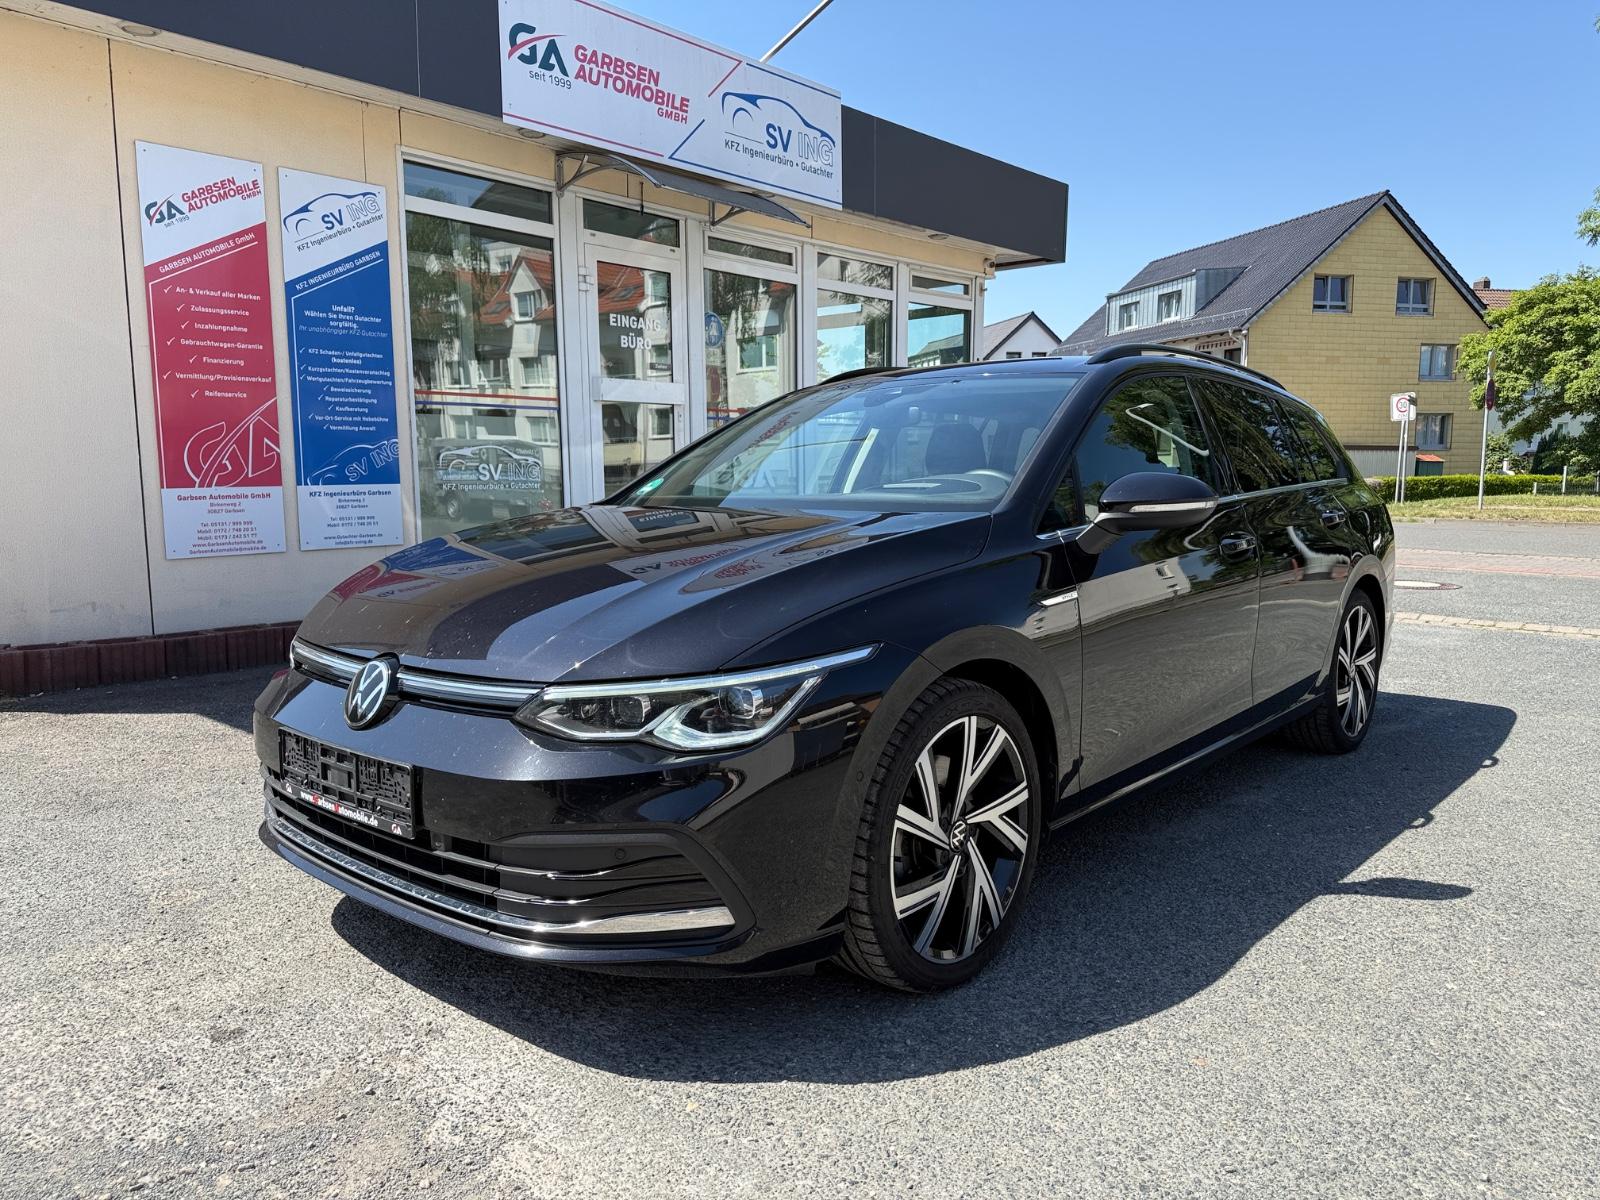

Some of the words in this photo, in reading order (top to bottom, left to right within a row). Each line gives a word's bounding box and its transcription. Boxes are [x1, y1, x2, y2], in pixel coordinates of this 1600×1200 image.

[574, 44, 661, 87] GARBSEN
[529, 69, 547, 82] seit
[549, 74, 572, 90] 1999
[574, 64, 690, 114] AUTOMOBILE
[657, 107, 688, 125] GMBH
[765, 122, 792, 153] SV
[798, 131, 834, 167] ING
[724, 139, 741, 154] KFZ
[742, 144, 794, 169] Ingenieurbüro
[801, 162, 834, 180] Gutachter
[181, 176, 236, 202] GARBSEN
[187, 179, 260, 213] AUTOMOBILE
[241, 189, 262, 201] GMBH
[175, 215, 190, 225] 1999
[321, 209, 344, 231] SV
[346, 196, 380, 222] ING
[297, 241, 310, 252] KFZ
[311, 226, 352, 246] Ingenieurbüro
[356, 213, 384, 229] Gutachter
[159, 256, 193, 273] GARBSEN
[193, 240, 235, 261] AUTOMOBILE
[236, 232, 255, 245] GmbH
[296, 280, 309, 291] KFZ
[309, 262, 354, 284] INGENIEURBÜRO
[355, 251, 380, 266] GARBSEN
[176, 286, 188, 294] An-
[196, 288, 221, 297] Verkauf
[238, 292, 261, 301] Marken
[191, 305, 249, 316] Zulassungsservice
[304, 310, 327, 319] Wählen
[355, 315, 381, 323] Gutachter
[332, 305, 355, 313] Unfall?
[195, 322, 248, 333] Inzahlungnahme
[610, 313, 661, 332] EINGANG
[180, 338, 263, 350] Gebrauchtwagen-Garantie
[621, 333, 652, 350] BÜRO
[203, 356, 245, 366] Finanzierung
[204, 390, 247, 398] Reifenservice
[345, 457, 368, 481] SV
[478, 463, 502, 481] SV
[508, 463, 541, 481] ING
[324, 490, 366, 498] Ingenieurbüro
[443, 483, 456, 491] KFZ
[458, 483, 504, 491] Ingenieurbüro
[208, 493, 249, 501] Automobile
